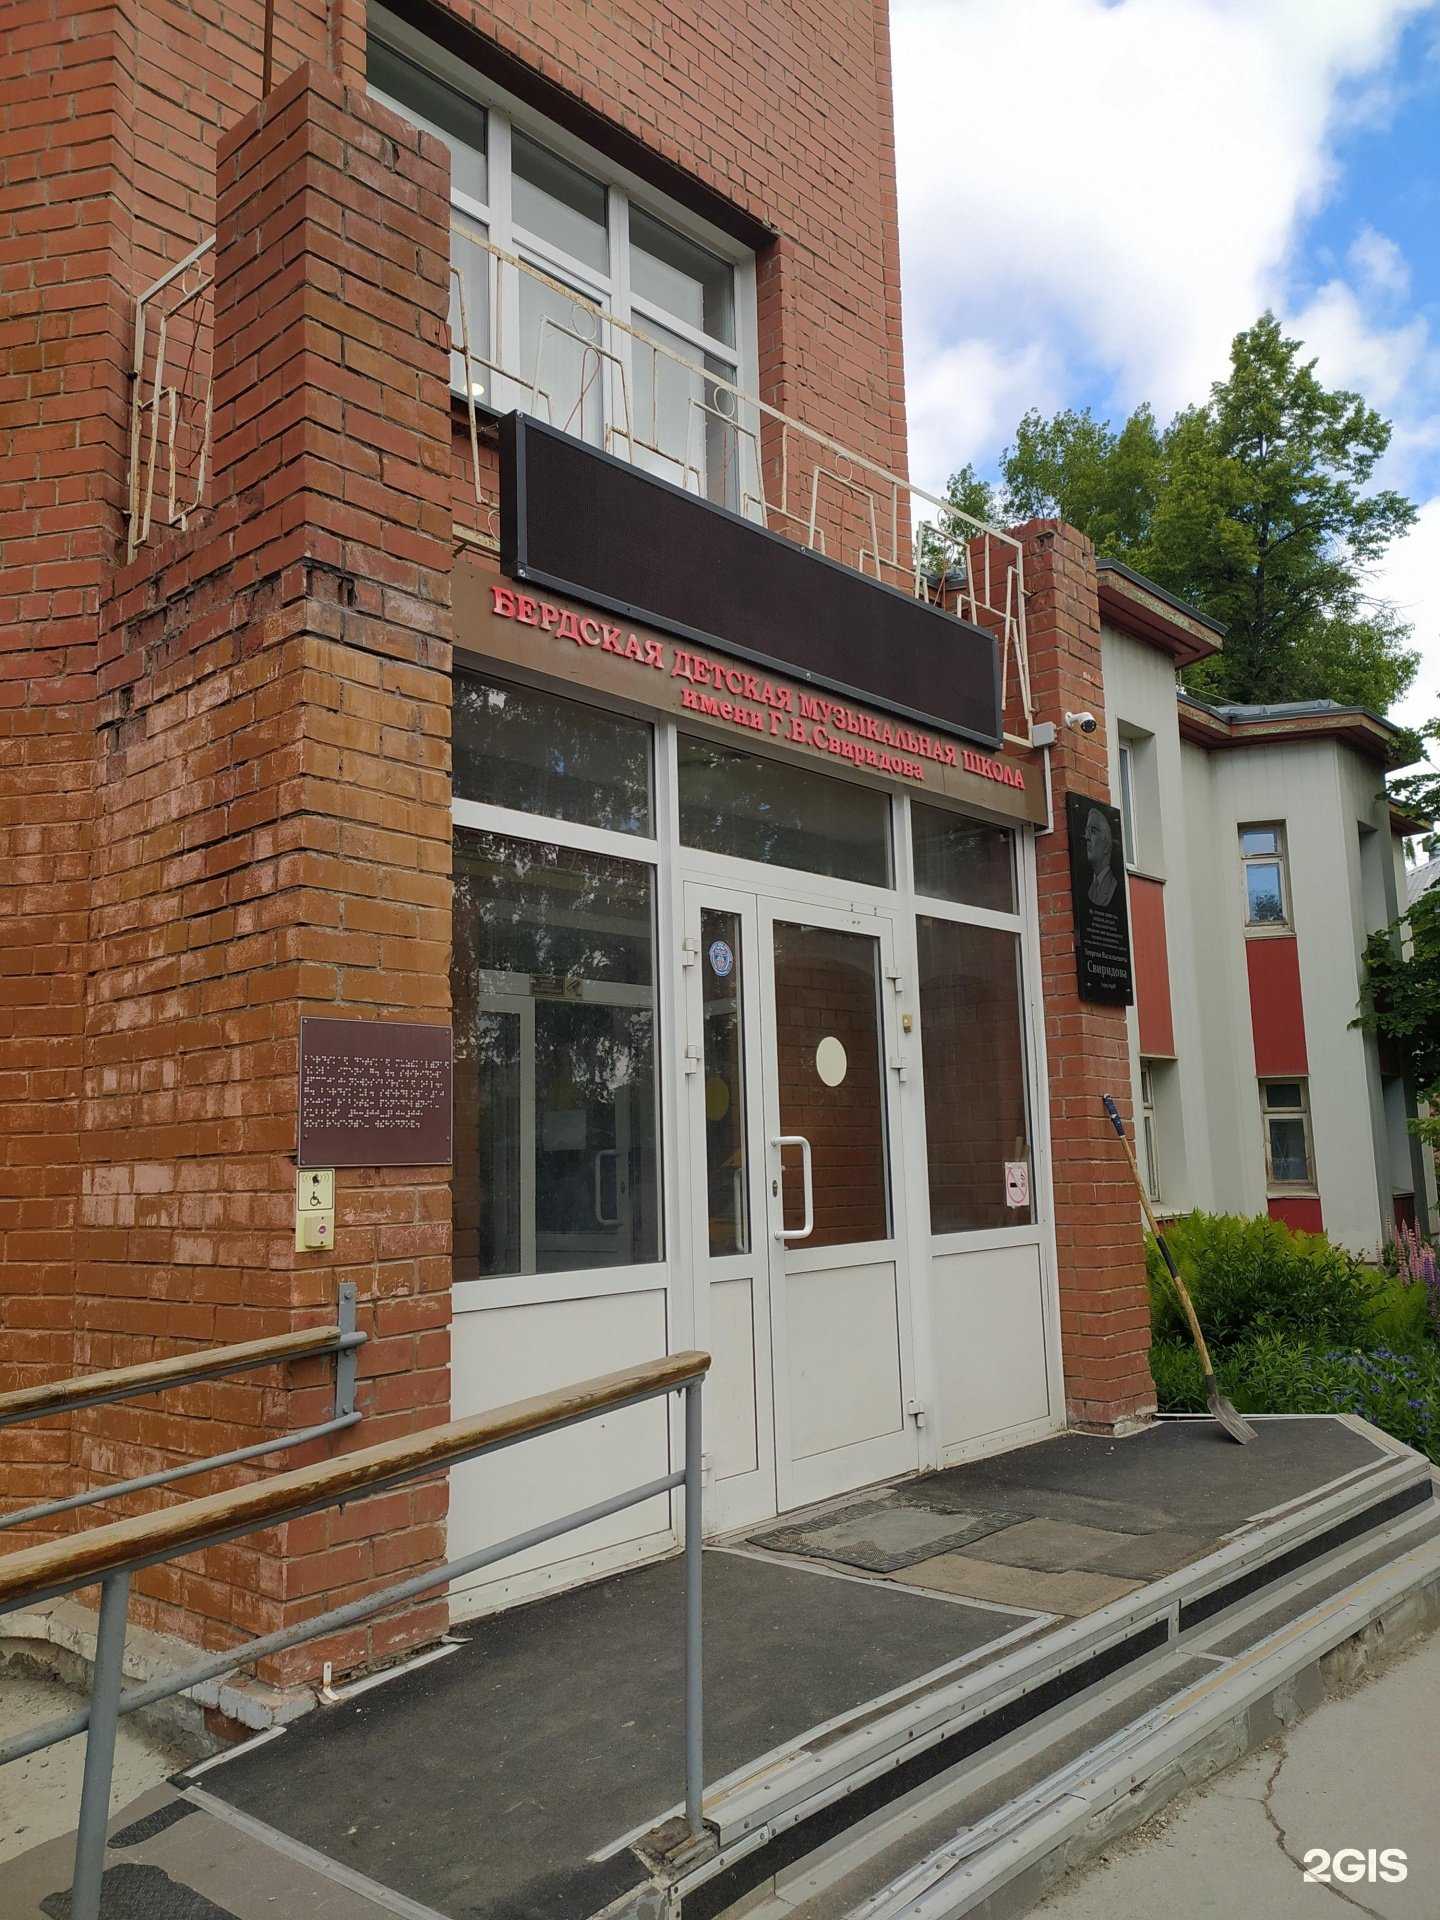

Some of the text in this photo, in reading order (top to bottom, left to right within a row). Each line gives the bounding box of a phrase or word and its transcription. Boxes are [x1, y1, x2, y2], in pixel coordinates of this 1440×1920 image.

[491, 585, 1025, 790] БЕРДСКАЯ ДЕТСКАЯ МУЗЫКАЛЬНАЯ ШКОЛА
[681, 687, 764, 731] имени
